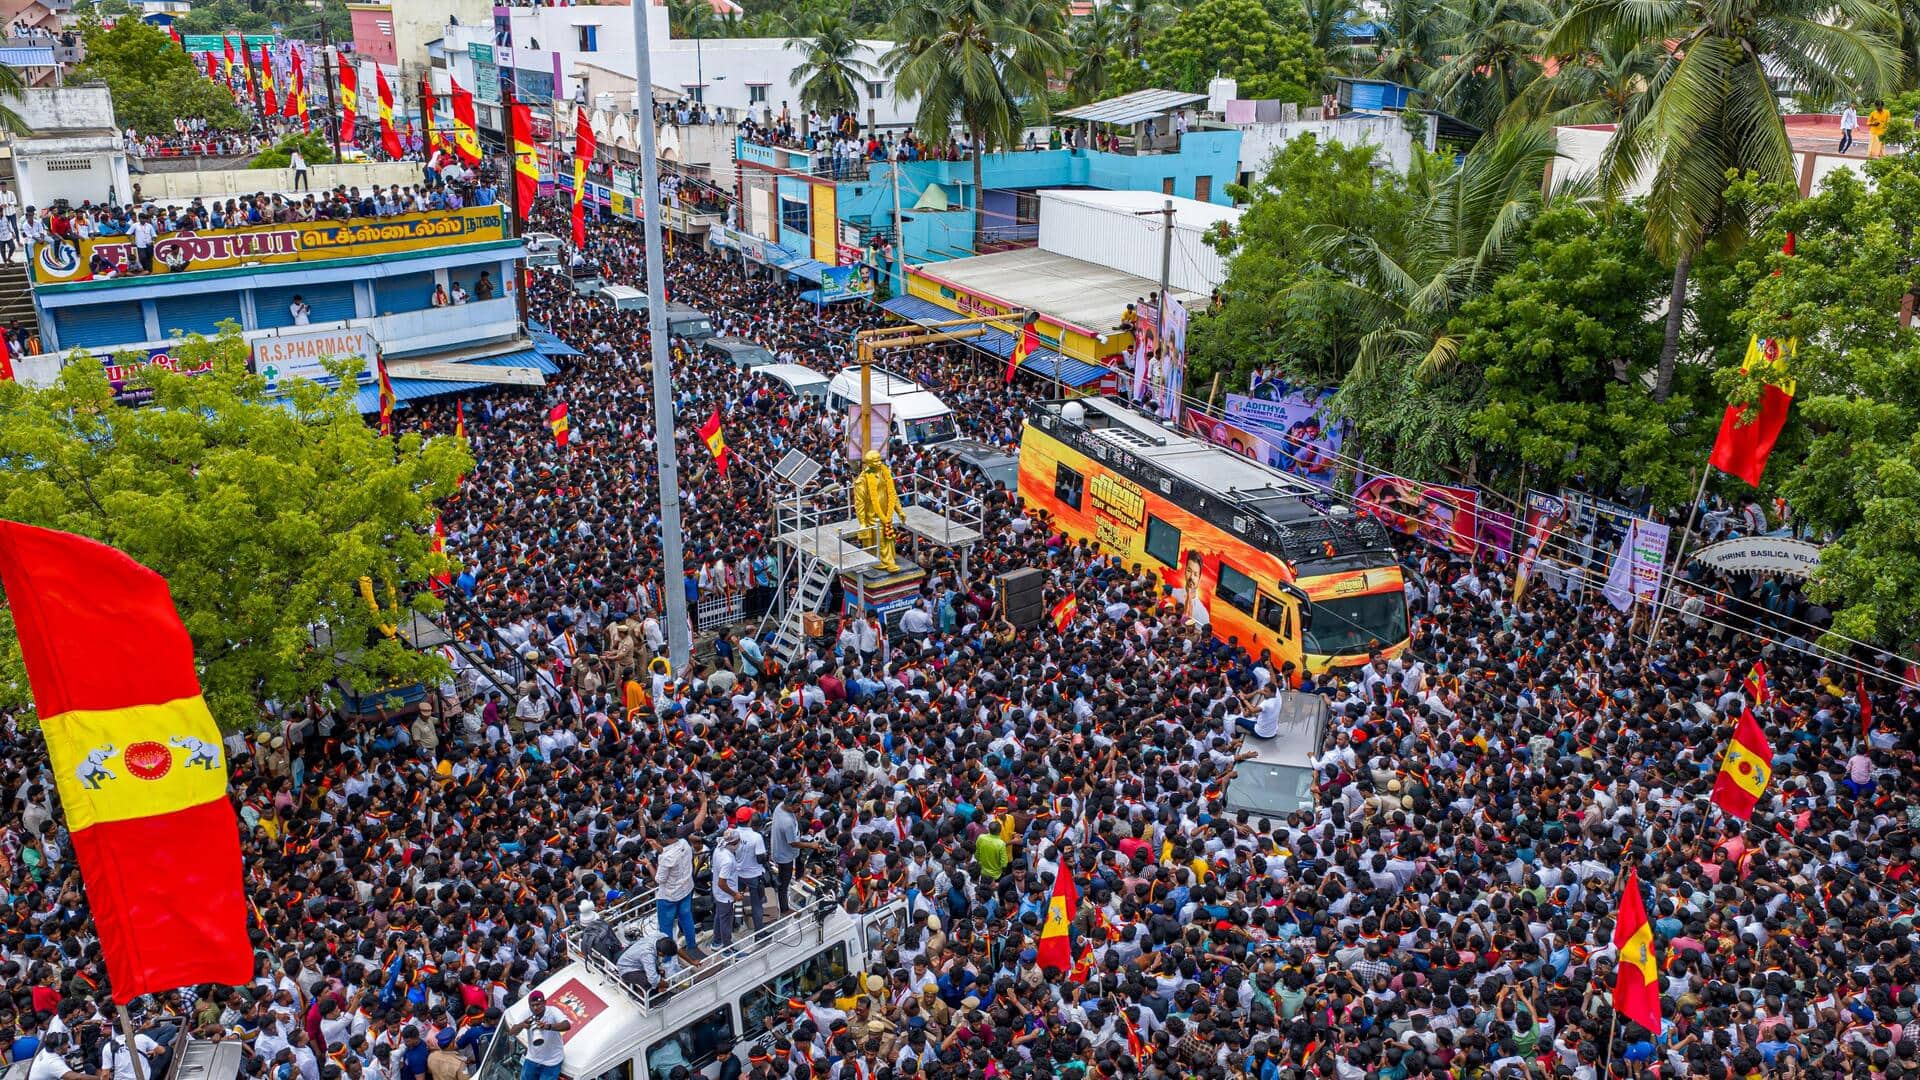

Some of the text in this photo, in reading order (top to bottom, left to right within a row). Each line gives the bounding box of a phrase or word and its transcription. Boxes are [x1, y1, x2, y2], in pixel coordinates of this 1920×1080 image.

[302, 217, 462, 247] டெக்ஸ்டைல்ஸ்
[465, 215, 500, 234] நாகை
[260, 335, 363, 362] R.S.PHARMACY
[1243, 408, 1288, 420] MATERNITY CARE
[1245, 401, 1286, 414] ADITHYA
[1717, 551, 1746, 561] SHRINE
[1751, 550, 1789, 559] BASILICA
